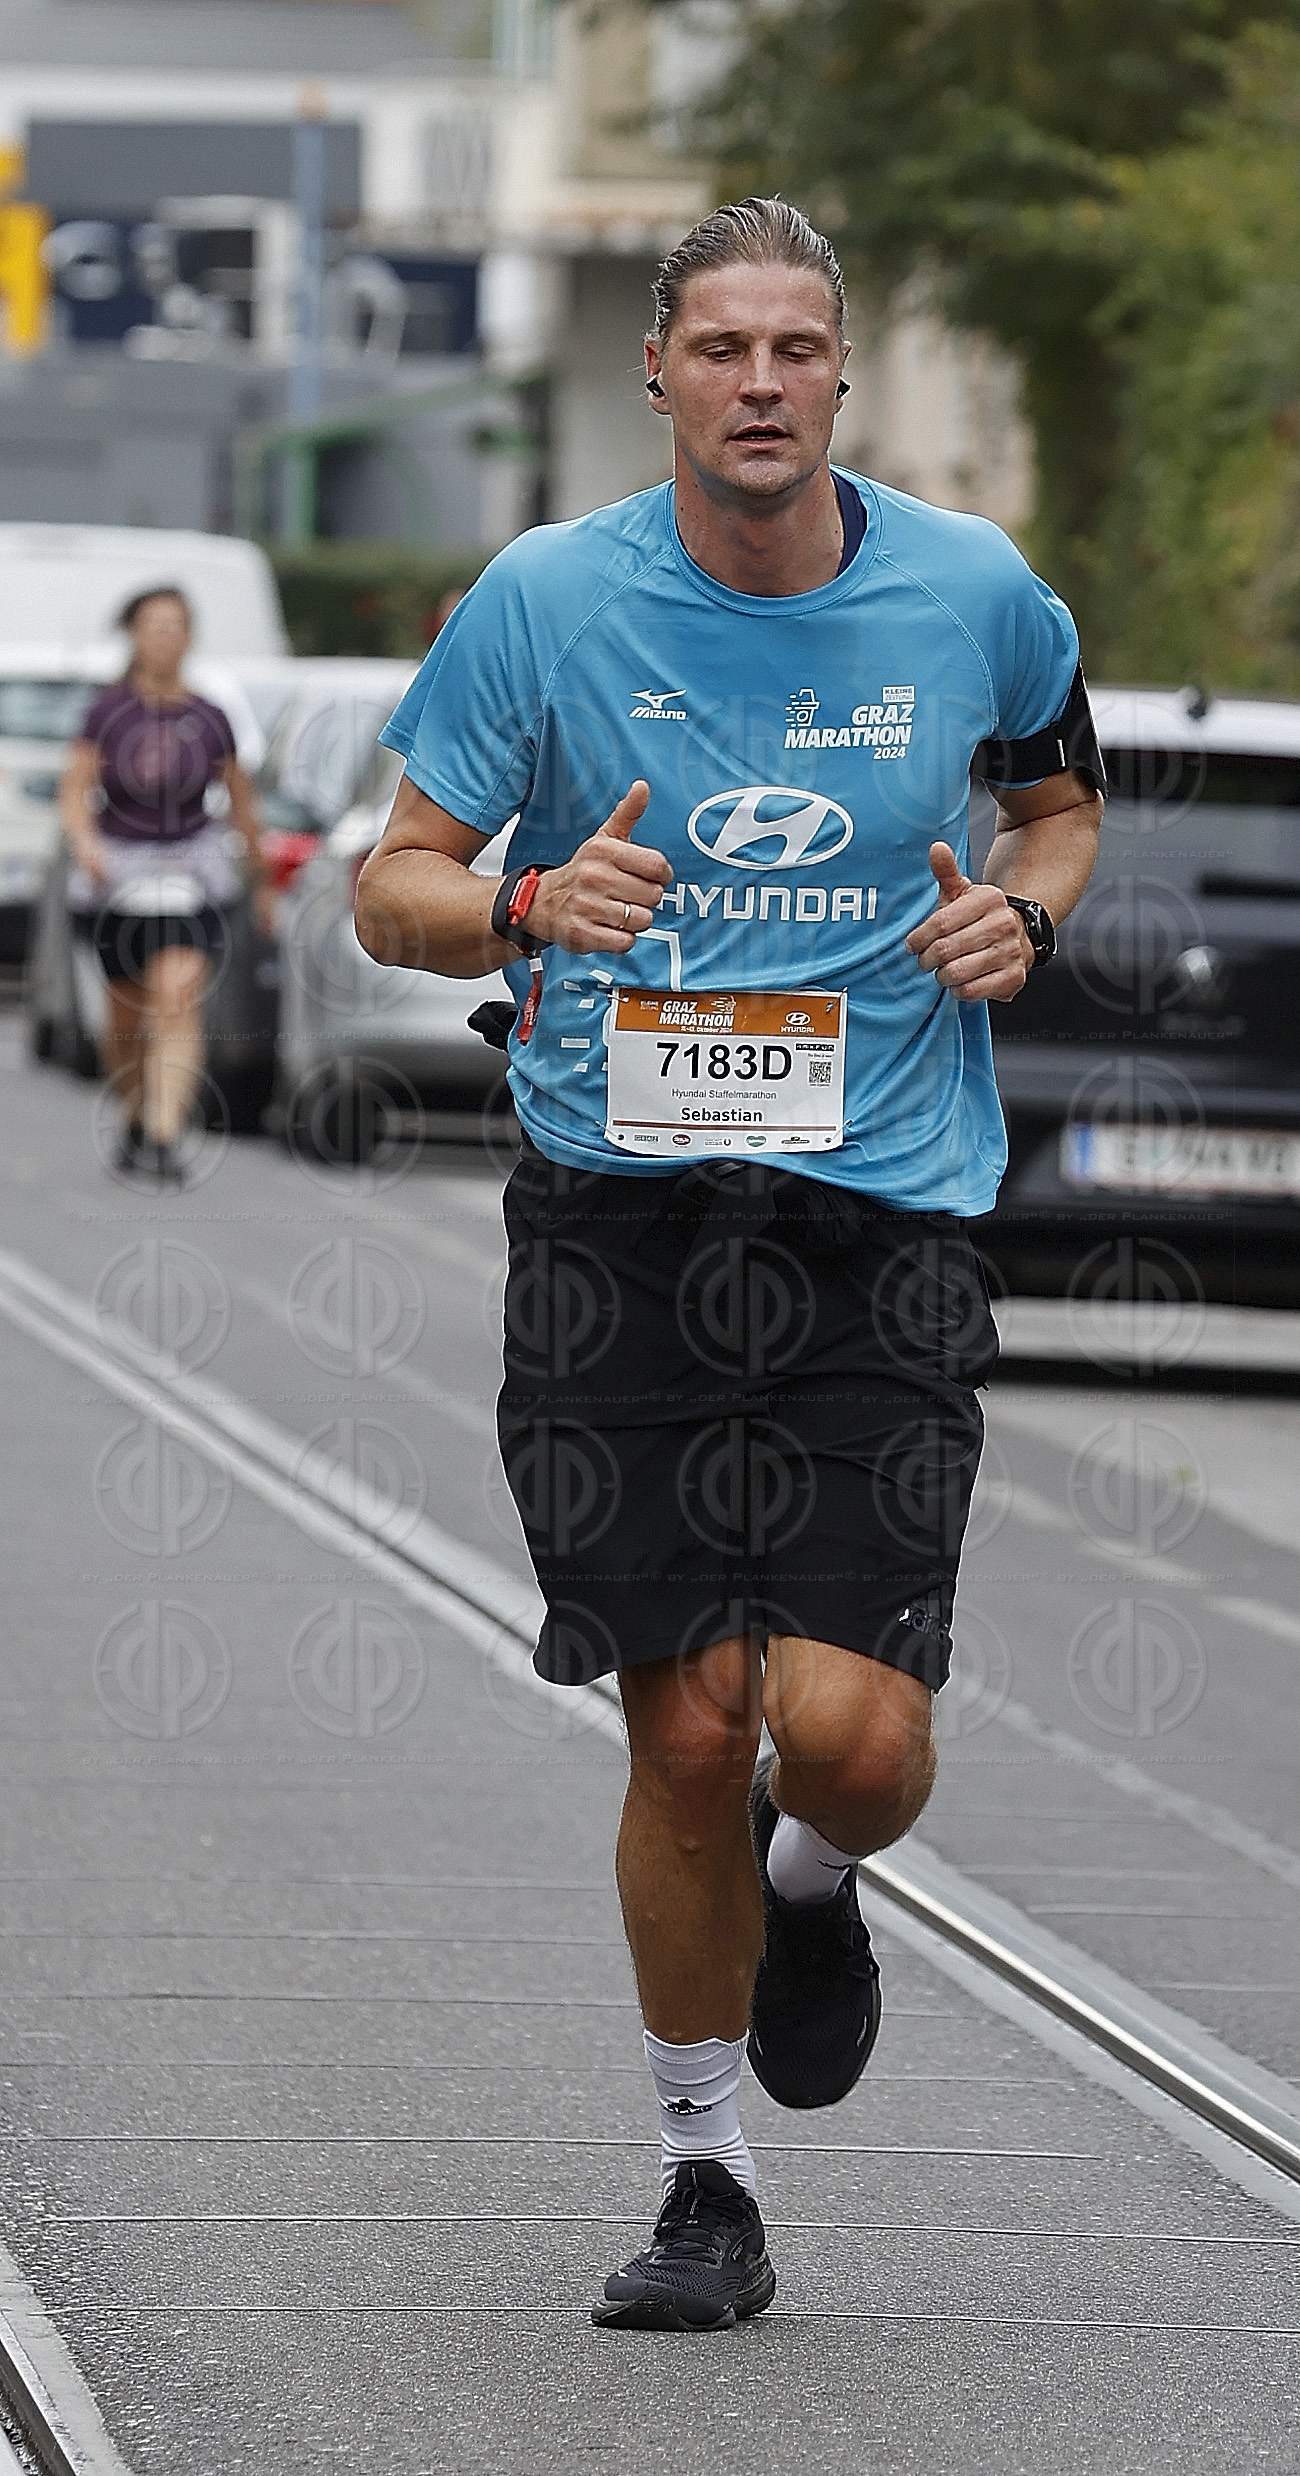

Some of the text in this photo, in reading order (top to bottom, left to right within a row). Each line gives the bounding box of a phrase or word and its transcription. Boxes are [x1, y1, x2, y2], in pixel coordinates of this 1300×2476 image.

[629, 707, 687, 720] MIZUNO
[851, 704, 914, 725] GRAZ
[785, 725, 912, 748] MARATHON
[873, 746, 906, 760] 2024
[657, 883, 878, 921] HYUNDAI
[662, 1000, 697, 1013] GRAZ
[659, 1012, 734, 1026] MARATHON
[656, 1042, 793, 1080] 7183D
[672, 1088, 777, 1100] Hyundai Staffelmarathon
[681, 1107, 763, 1122] Sebastian
